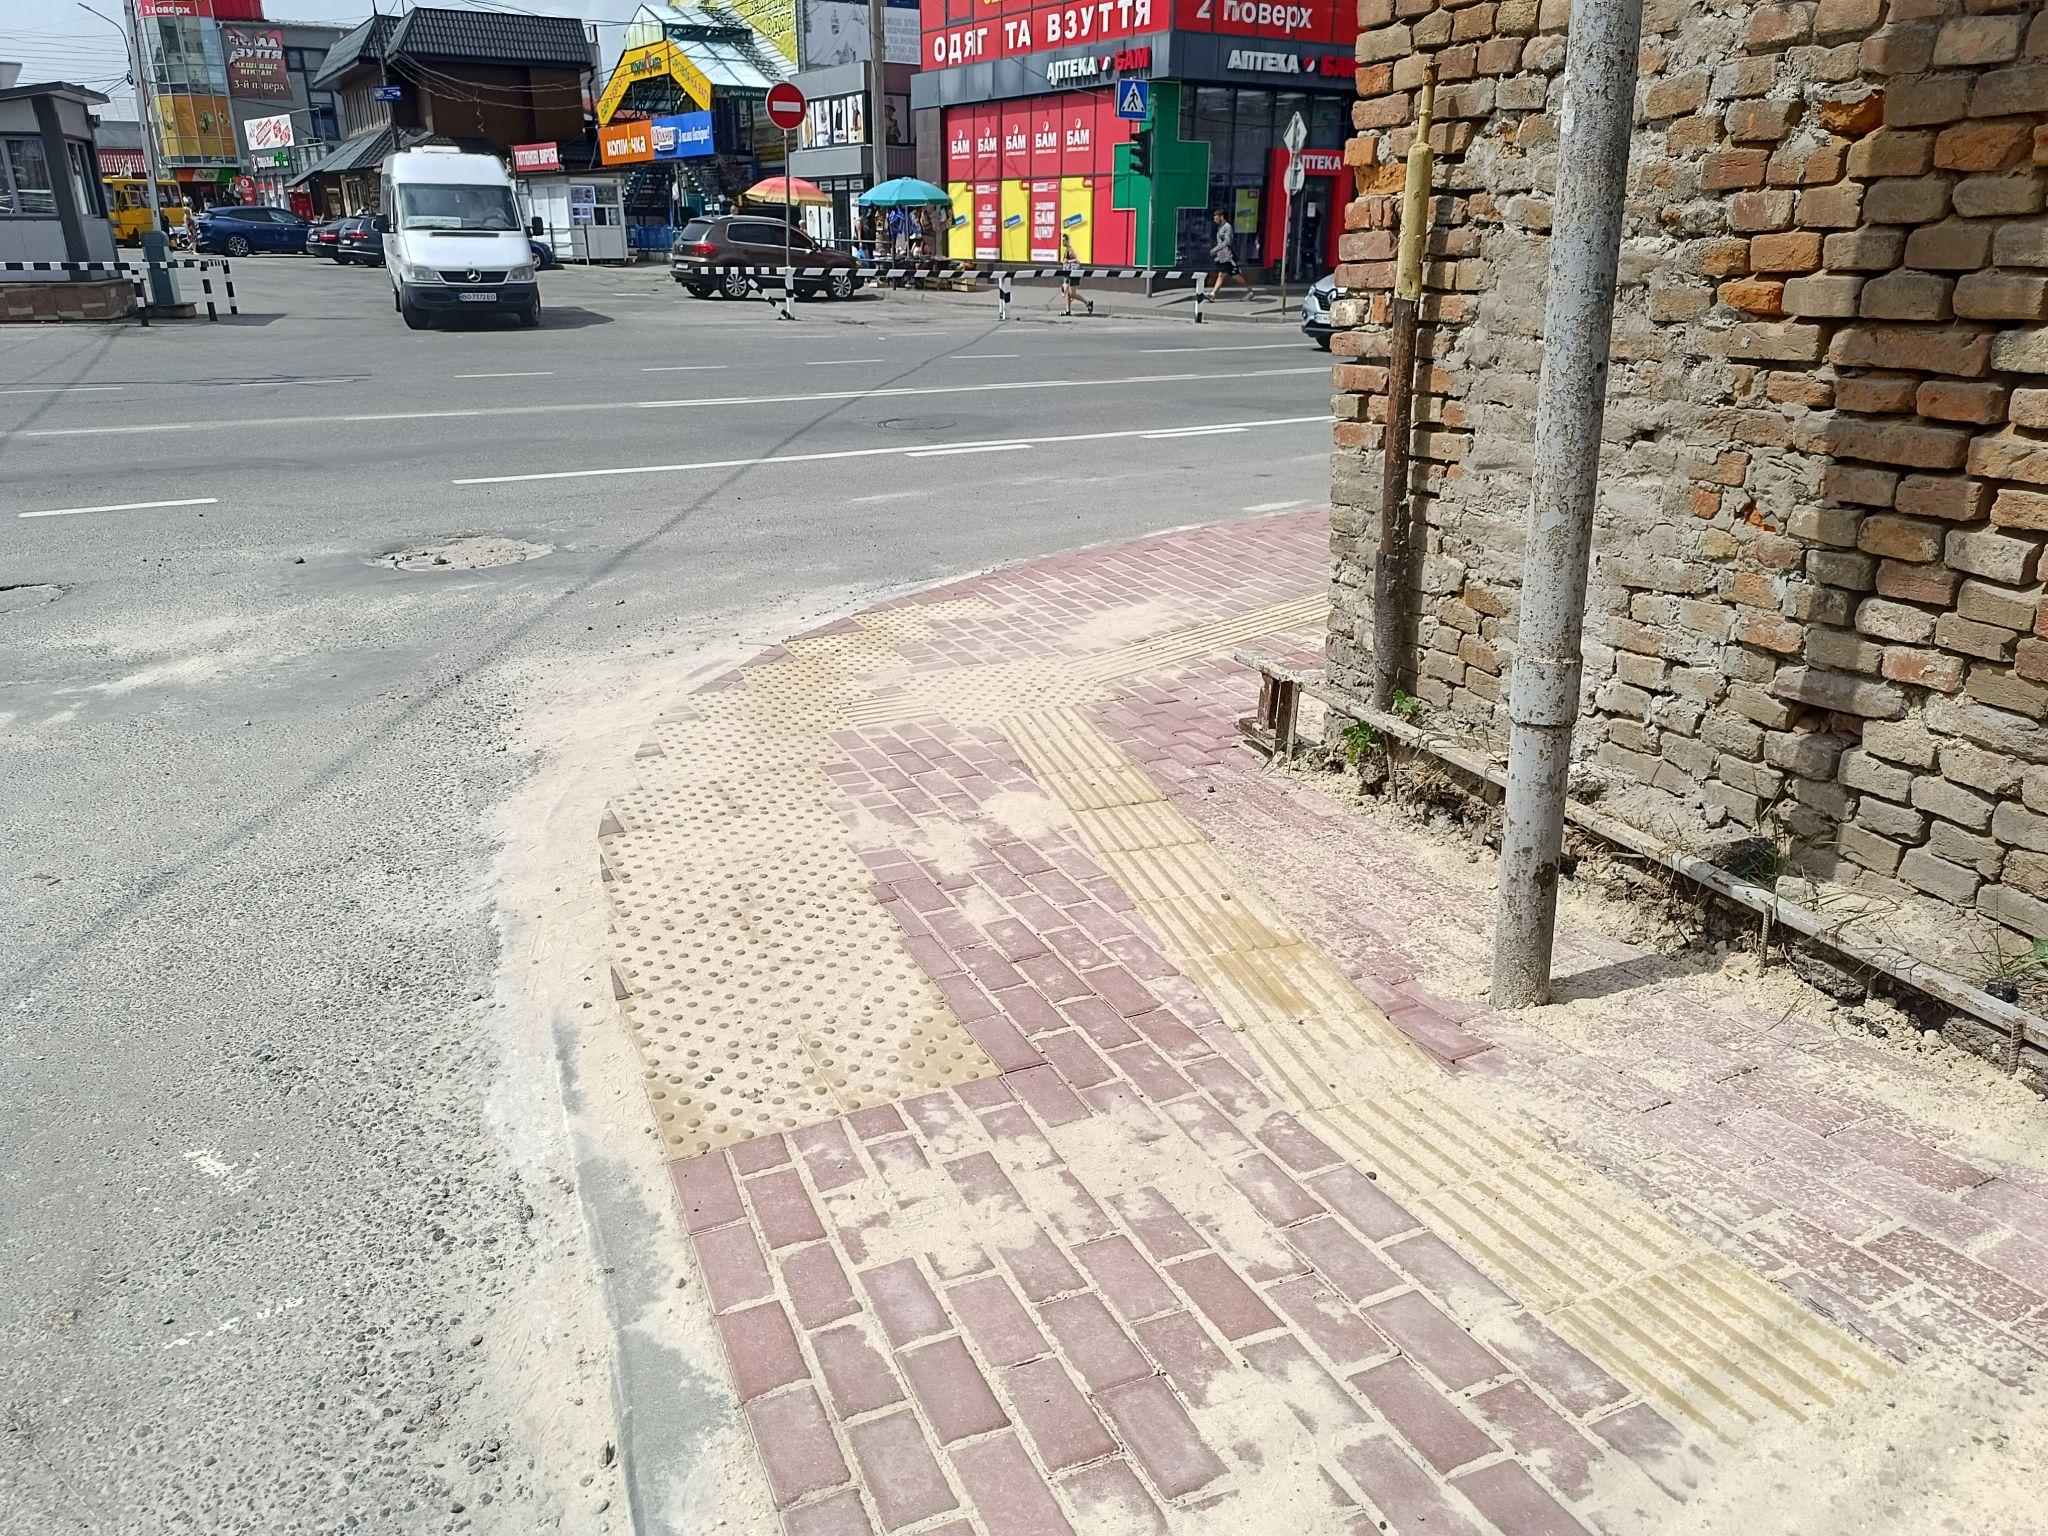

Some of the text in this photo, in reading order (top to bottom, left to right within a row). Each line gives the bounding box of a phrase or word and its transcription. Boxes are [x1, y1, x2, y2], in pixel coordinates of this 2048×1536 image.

[151, 6, 191, 18] поверх
[1196, 0, 1211, 19] 2
[933, 28, 988, 64] ОДЯГ
[1004, 20, 1031, 49] ТА
[1047, 0, 1151, 42] ВЗУТТЯ
[1047, 47, 1152, 82] АПТЕКА БАМ
[1227, 50, 1300, 74] АПТЕКА
[977, 137, 997, 152] БАМ
[1005, 135, 1026, 150] БАМ
[1035, 132, 1057, 148] БАМ
[1066, 129, 1090, 145] БАМ
[951, 139, 970, 154] БАМ
[1301, 155, 1341, 170] ПТЕКА
